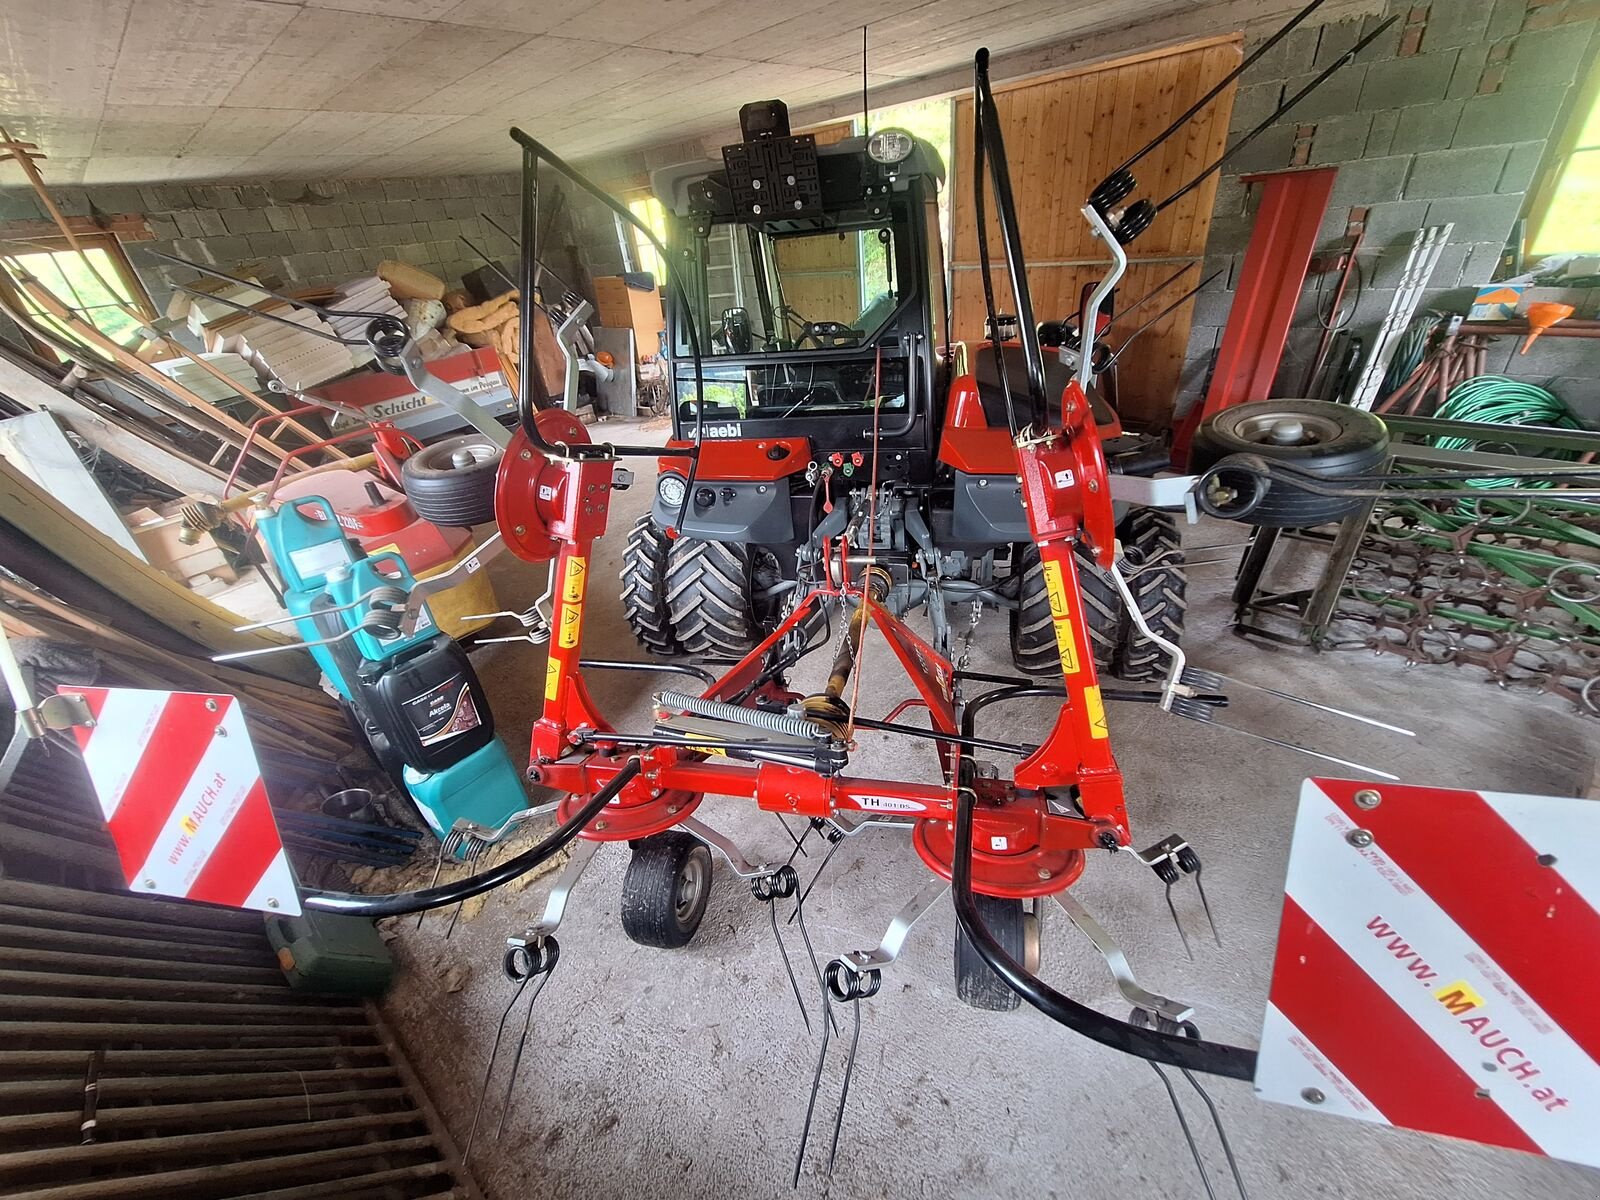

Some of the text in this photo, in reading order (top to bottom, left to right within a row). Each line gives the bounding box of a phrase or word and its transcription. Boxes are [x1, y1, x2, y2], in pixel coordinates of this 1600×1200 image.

[373, 396, 428, 419] Schicht
[709, 422, 742, 438] aebi
[861, 797, 880, 807] TH
[168, 773, 227, 865] www.MAUCH.at
[1366, 915, 1569, 1112] www.MAUCH.at
